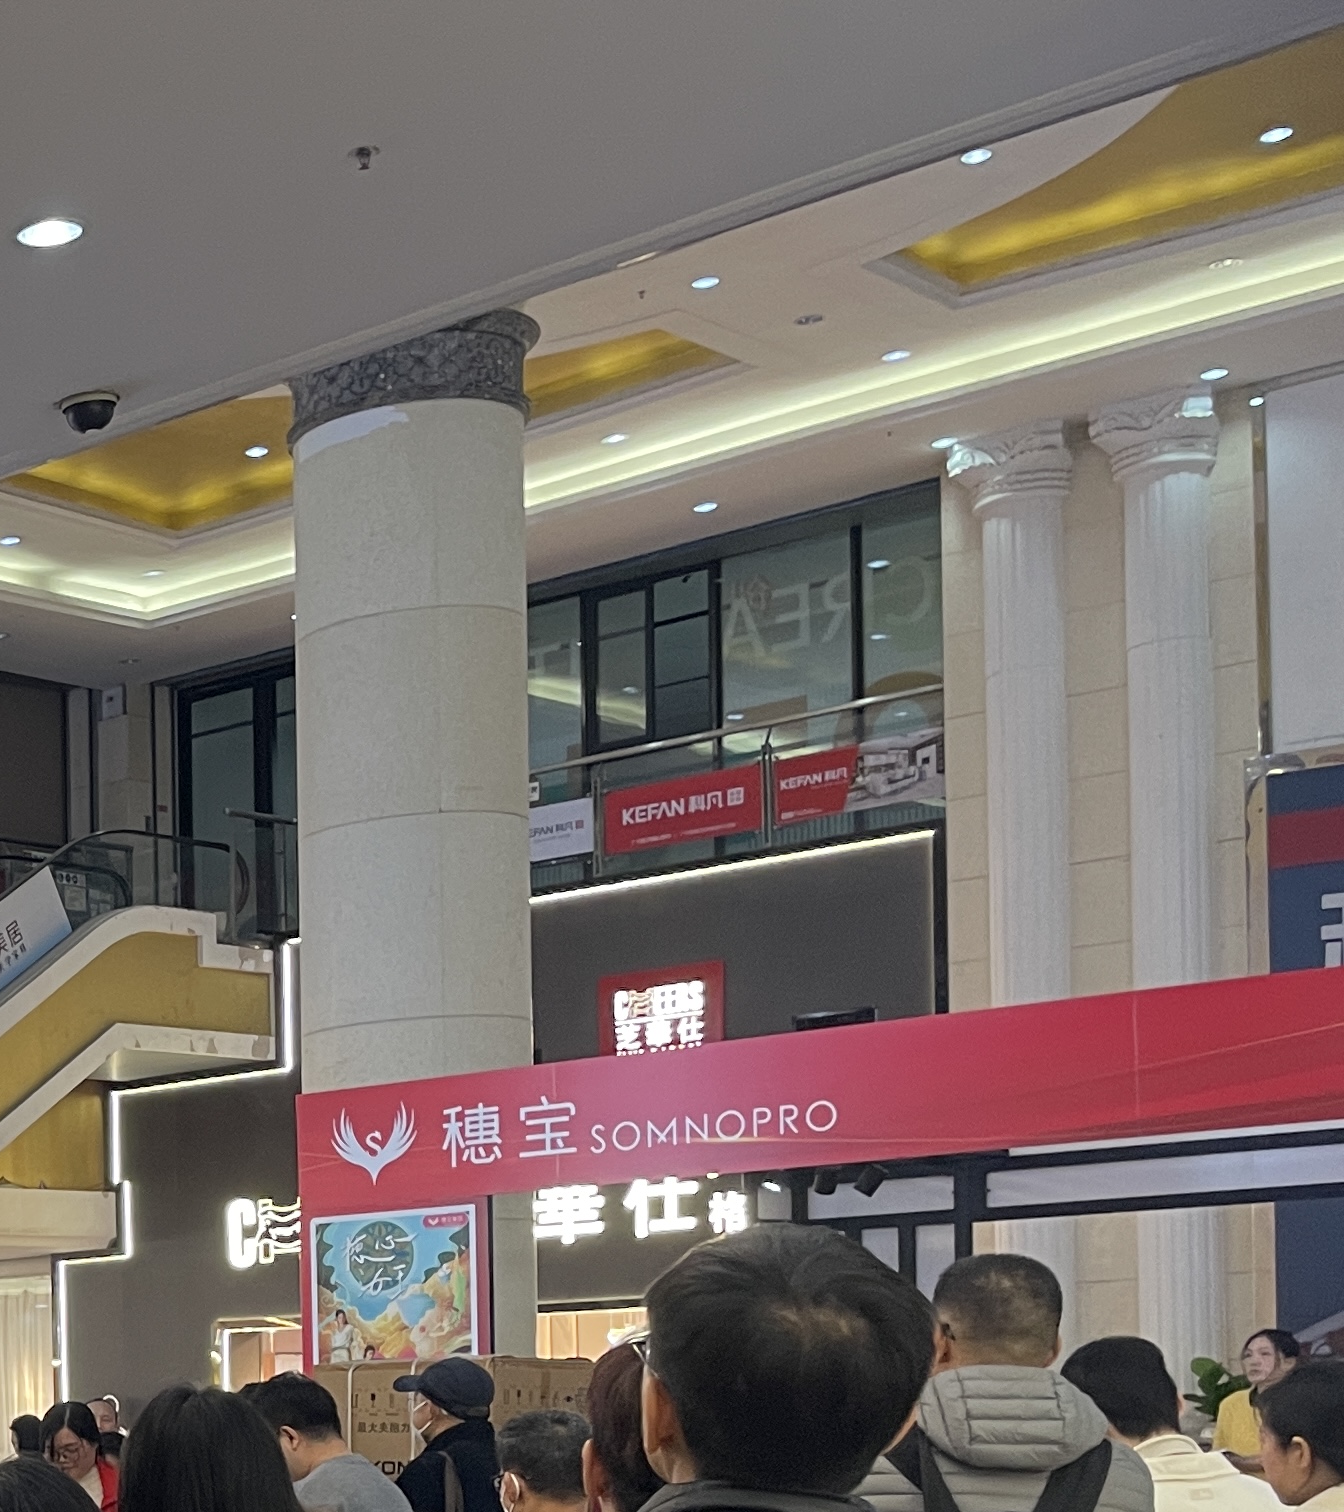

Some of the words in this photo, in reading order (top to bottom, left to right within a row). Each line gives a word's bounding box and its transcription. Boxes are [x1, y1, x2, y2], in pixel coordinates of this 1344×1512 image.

[779, 772, 823, 791] KEFAN
[622, 798, 685, 826] KEFAN
[688, 791, 723, 813] 科凡
[529, 826, 555, 838] EFAN
[441, 1095, 578, 1168] 穗宝
[590, 1099, 838, 1154] SOMNOPRO
